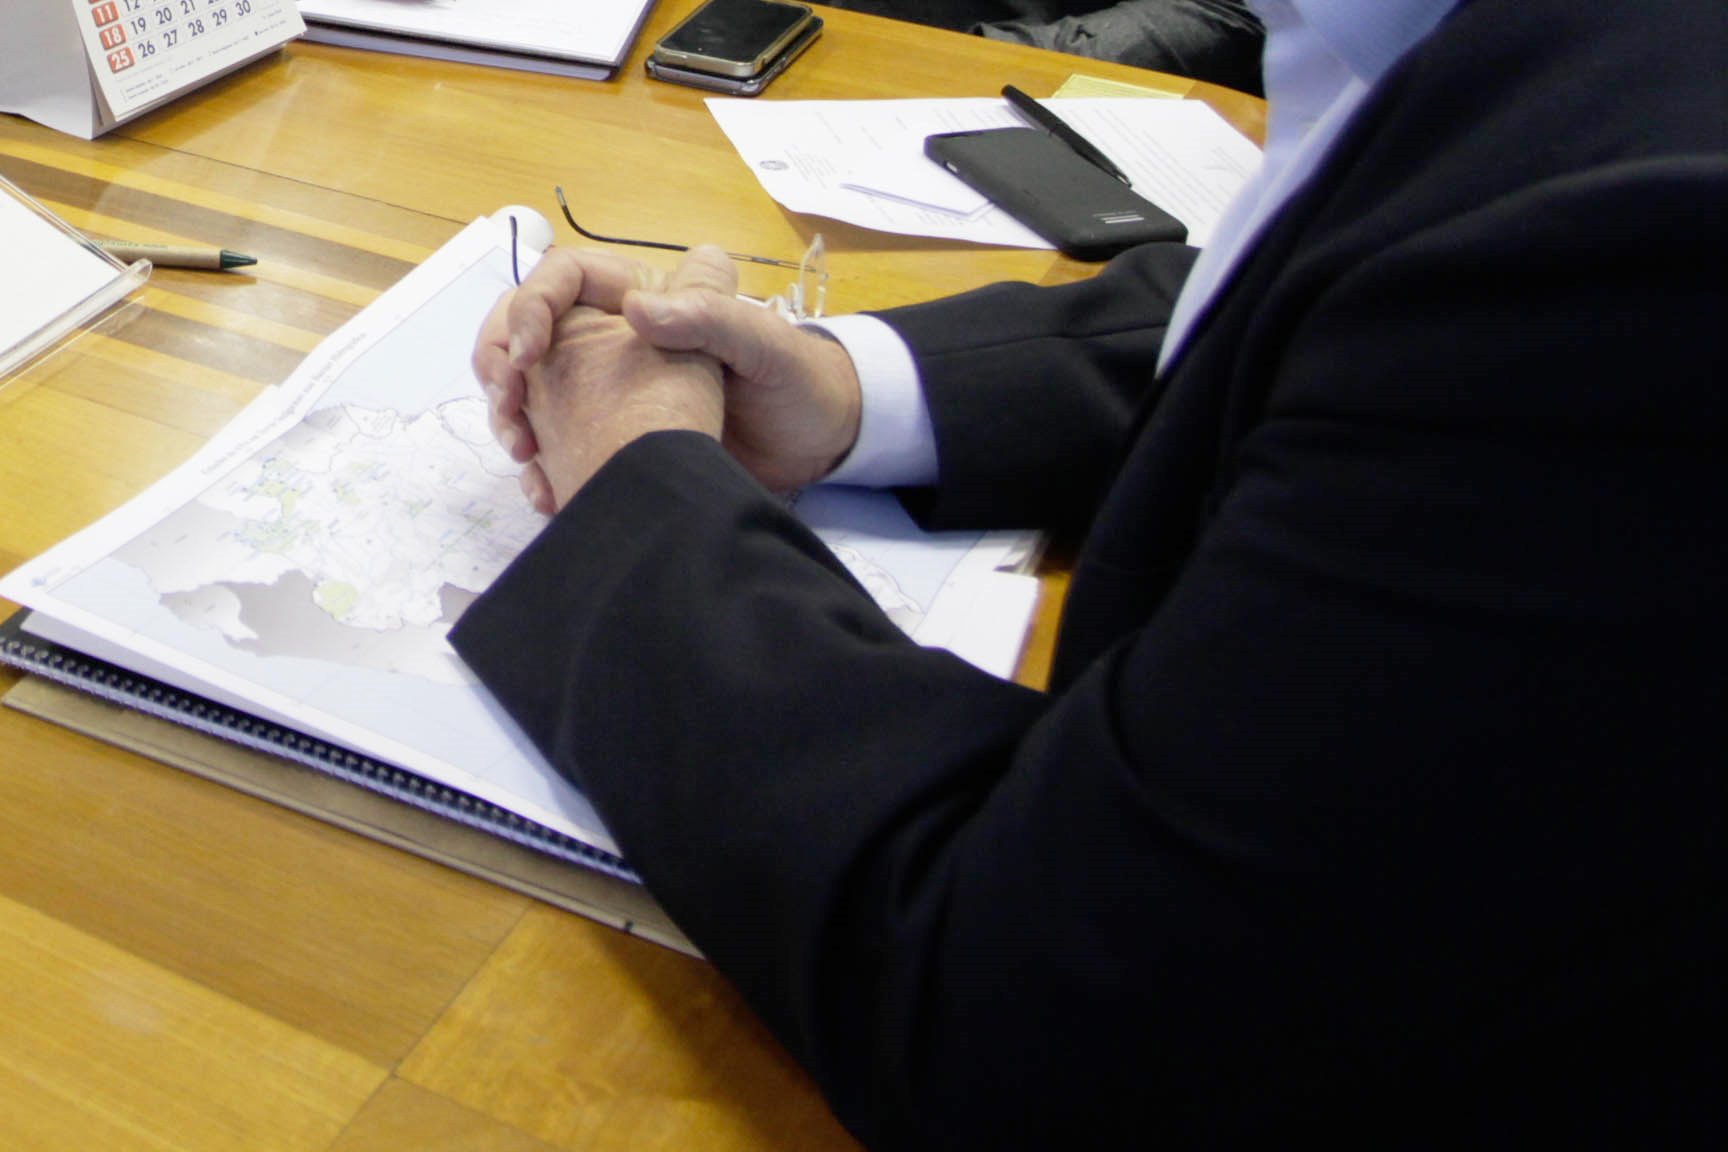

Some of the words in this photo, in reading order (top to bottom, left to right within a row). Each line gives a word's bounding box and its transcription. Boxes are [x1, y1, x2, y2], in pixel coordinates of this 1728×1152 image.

[97, 5, 114, 23] 11
[104, 27, 122, 46] 18
[131, 17, 146, 35] 19
[155, 7, 172, 24] 20
[111, 51, 130, 70] 25
[138, 40, 155, 58] 26
[164, 29, 177, 47] 27
[188, 19, 205, 37] 28
[212, 9, 227, 26] 29
[236, 0, 251, 16] 30
